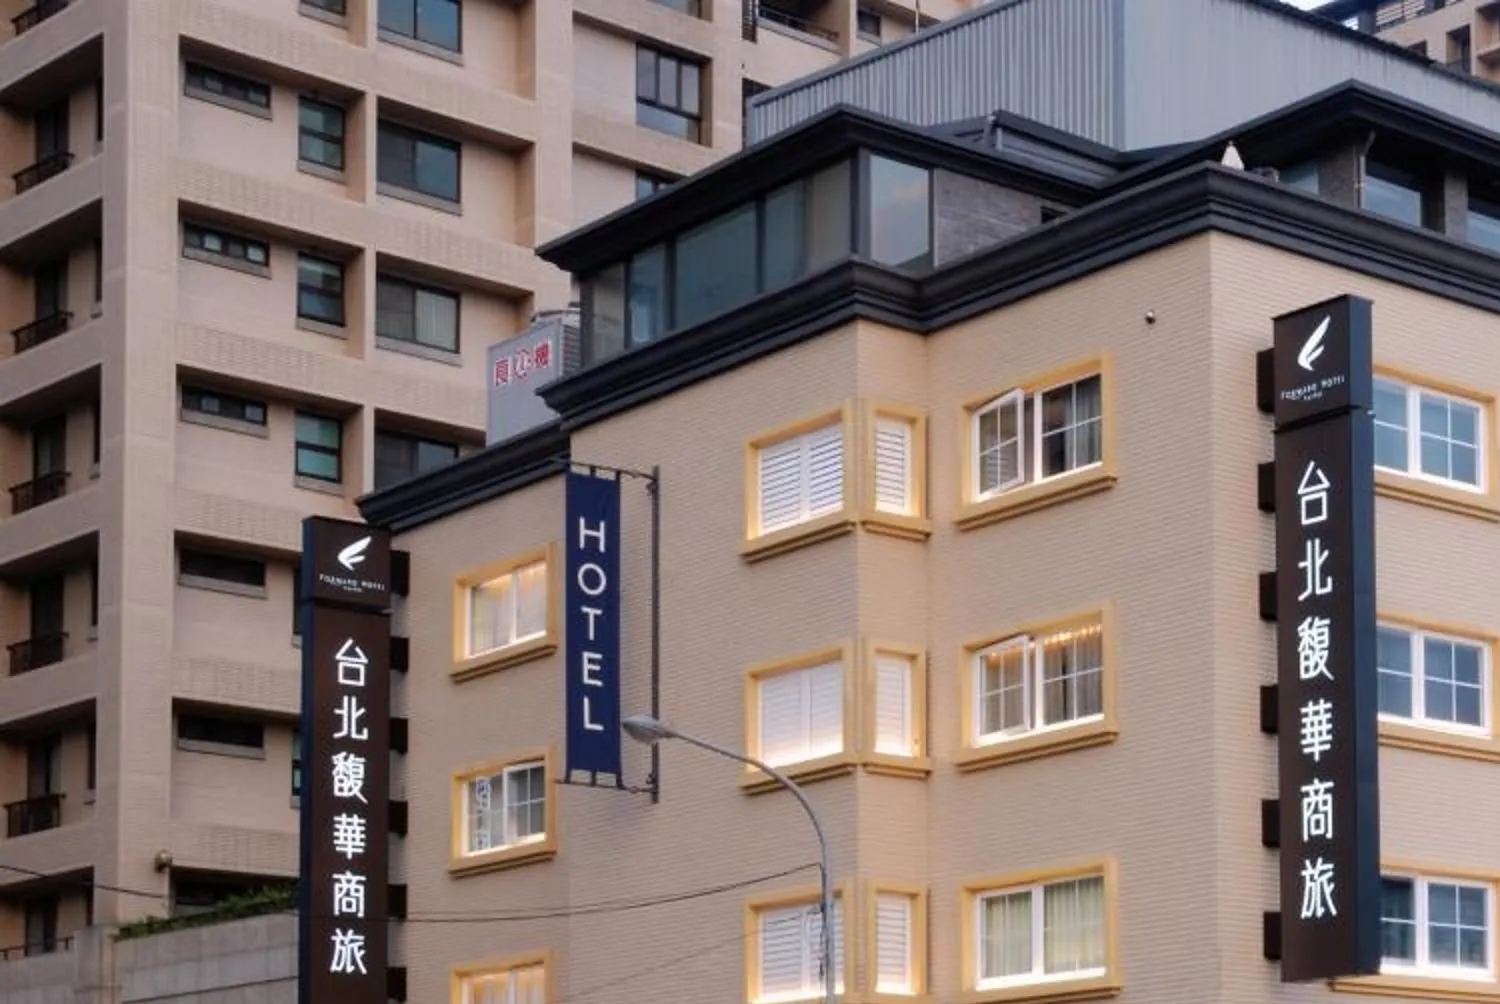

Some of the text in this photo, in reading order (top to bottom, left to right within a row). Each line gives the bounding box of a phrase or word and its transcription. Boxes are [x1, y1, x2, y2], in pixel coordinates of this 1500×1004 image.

[577, 516, 607, 731] HOTEL
[1297, 461, 1337, 919] 台北馥華商旅
[330, 638, 369, 975] 台北馥華商旅
